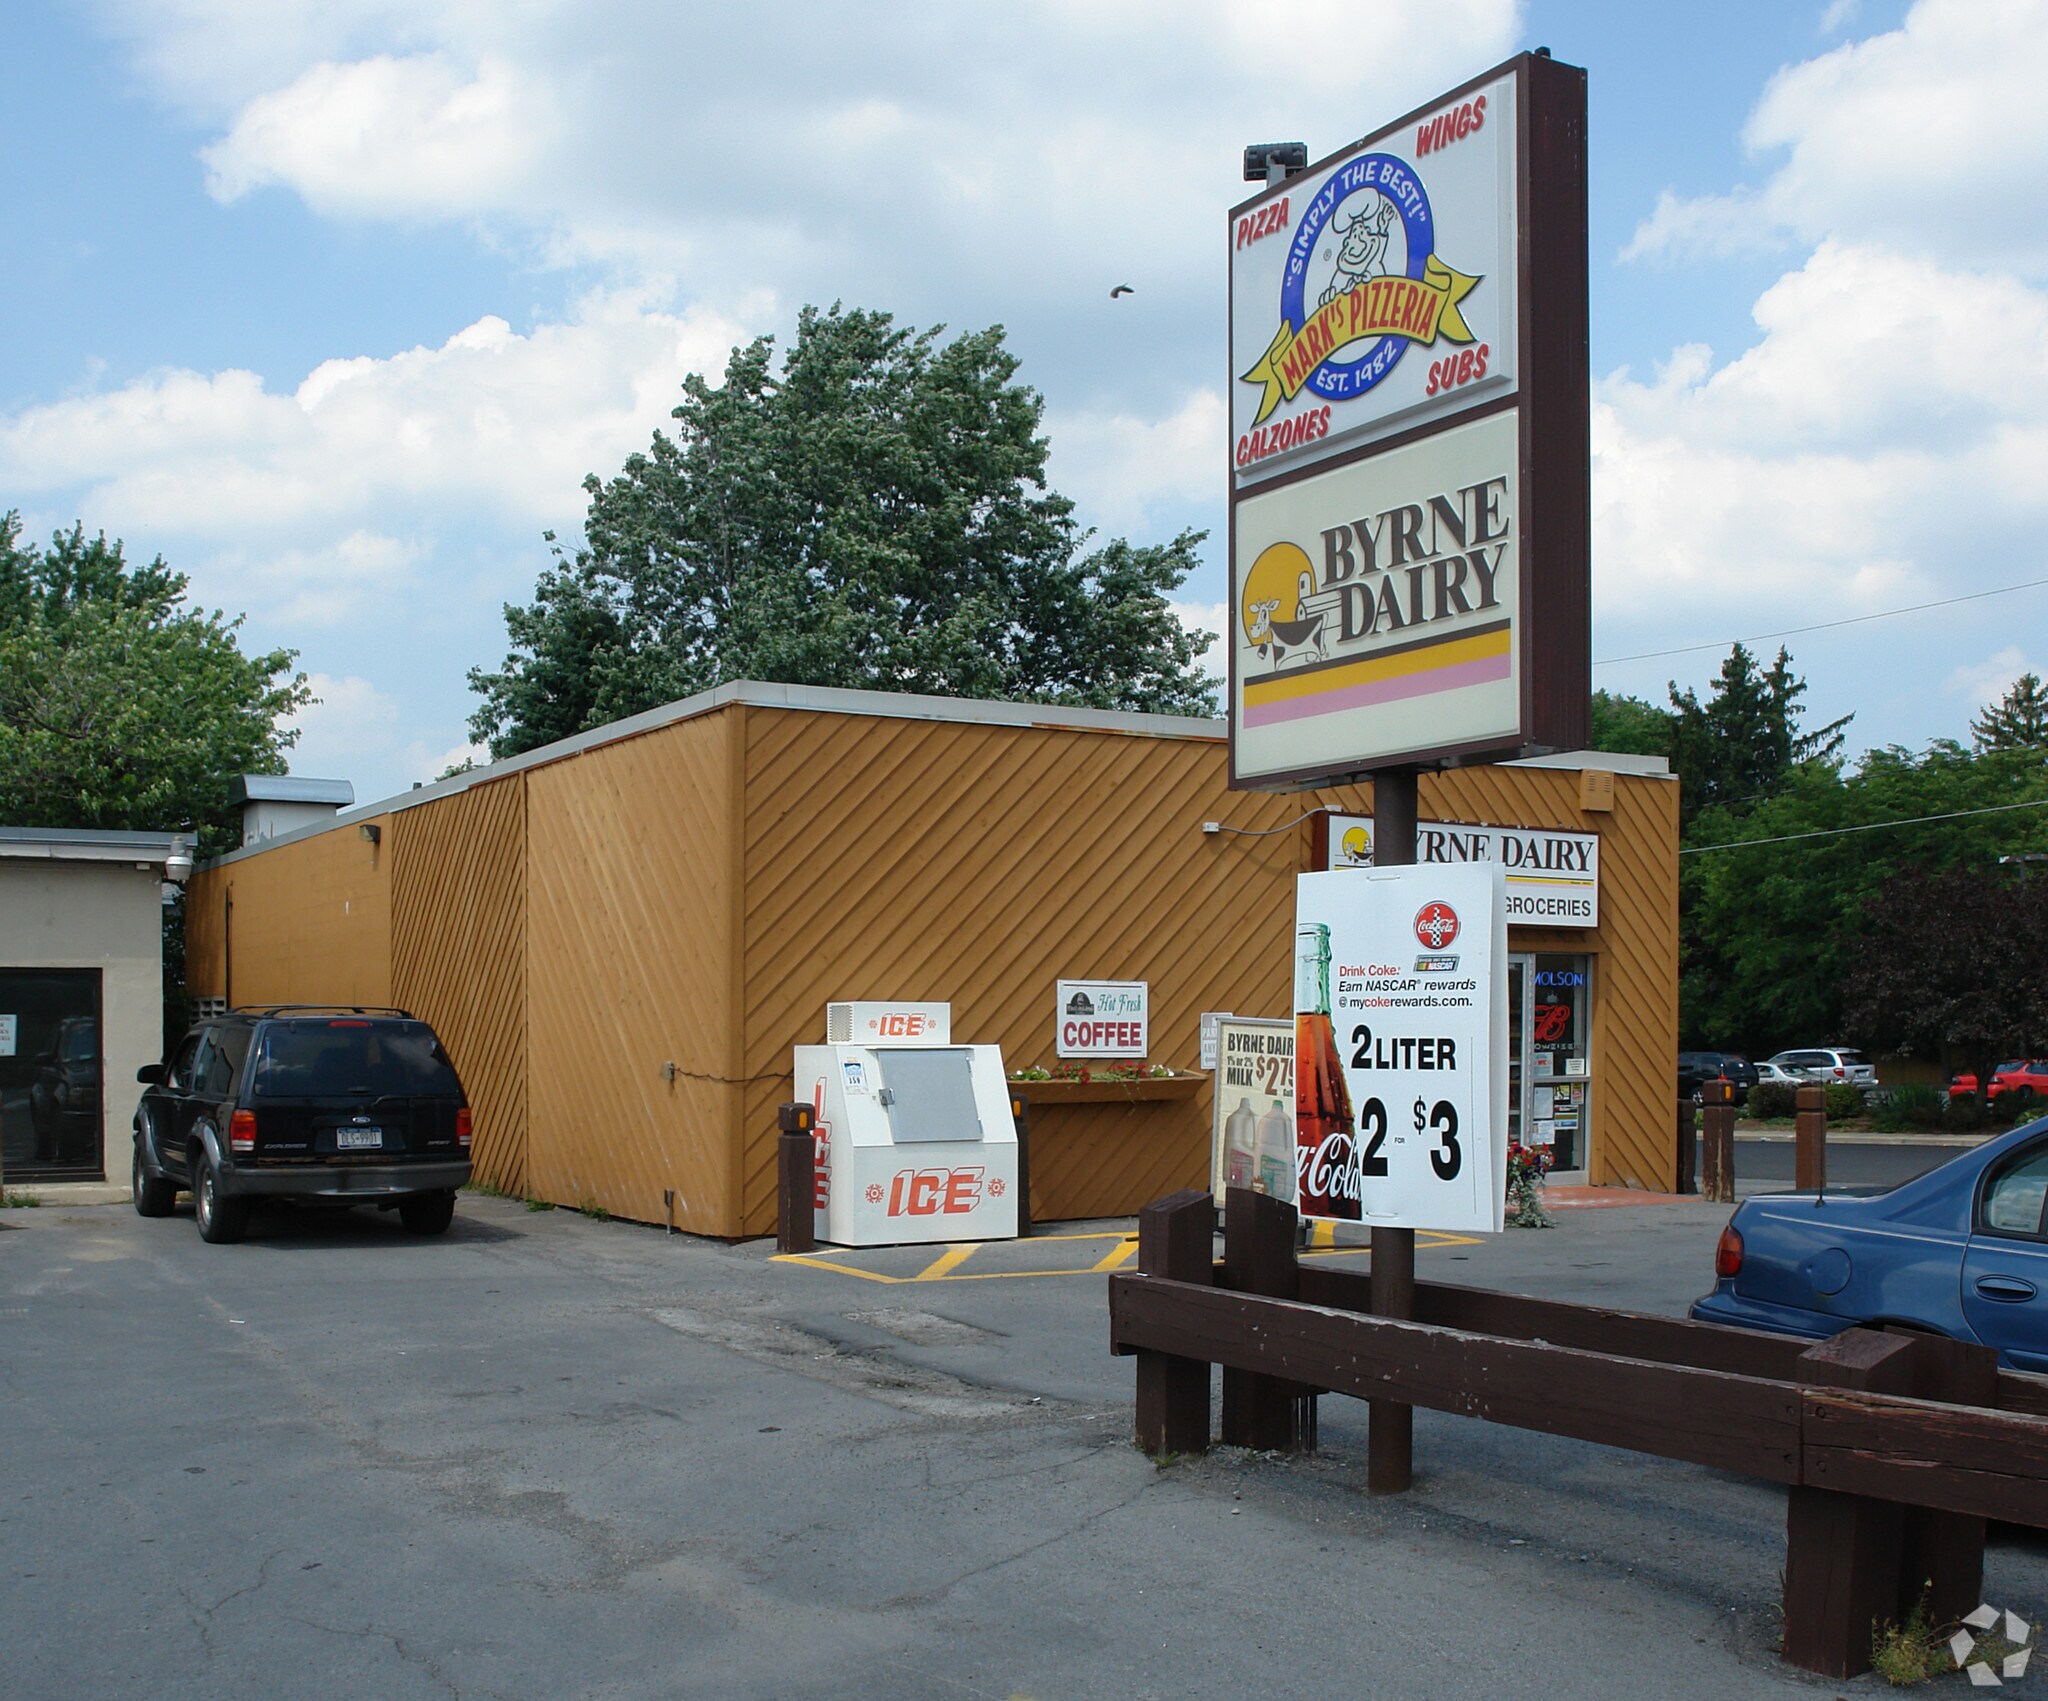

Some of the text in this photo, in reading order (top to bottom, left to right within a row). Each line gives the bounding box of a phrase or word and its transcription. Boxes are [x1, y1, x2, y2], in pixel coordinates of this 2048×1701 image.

[1416, 95, 1486, 157] WINGS
[1341, 160, 1378, 191] THE
[1237, 197, 1290, 250] PIZZA
[1281, 281, 1438, 392] MARK'S PIZZERIA
[1316, 340, 1398, 392] EST. 1982
[1425, 343, 1489, 396] SUBS
[1236, 404, 1331, 466] CALZONES
[1320, 476, 1510, 587] BYRNE
[1337, 543, 1508, 643] DAIRY
[1417, 830, 1595, 872] RNE DAIRY
[1506, 896, 1592, 917] GROCERIES
[1338, 981, 1363, 992] Earn
[1423, 979, 1476, 991] rewards
[1339, 964, 1400, 977] Drink Coke:
[878, 1012, 926, 1036] ICE
[1098, 993, 1141, 1016] Hot Fresh
[1349, 996, 1474, 1010] mycokerewards.com.
[1063, 1021, 1142, 1047] COFFEE
[1227, 1032, 1294, 1057] BYRNE DAIR
[1227, 1067, 1253, 1086] MILK
[1361, 1097, 1389, 1177] 2
[887, 1166, 985, 1217] ICE
